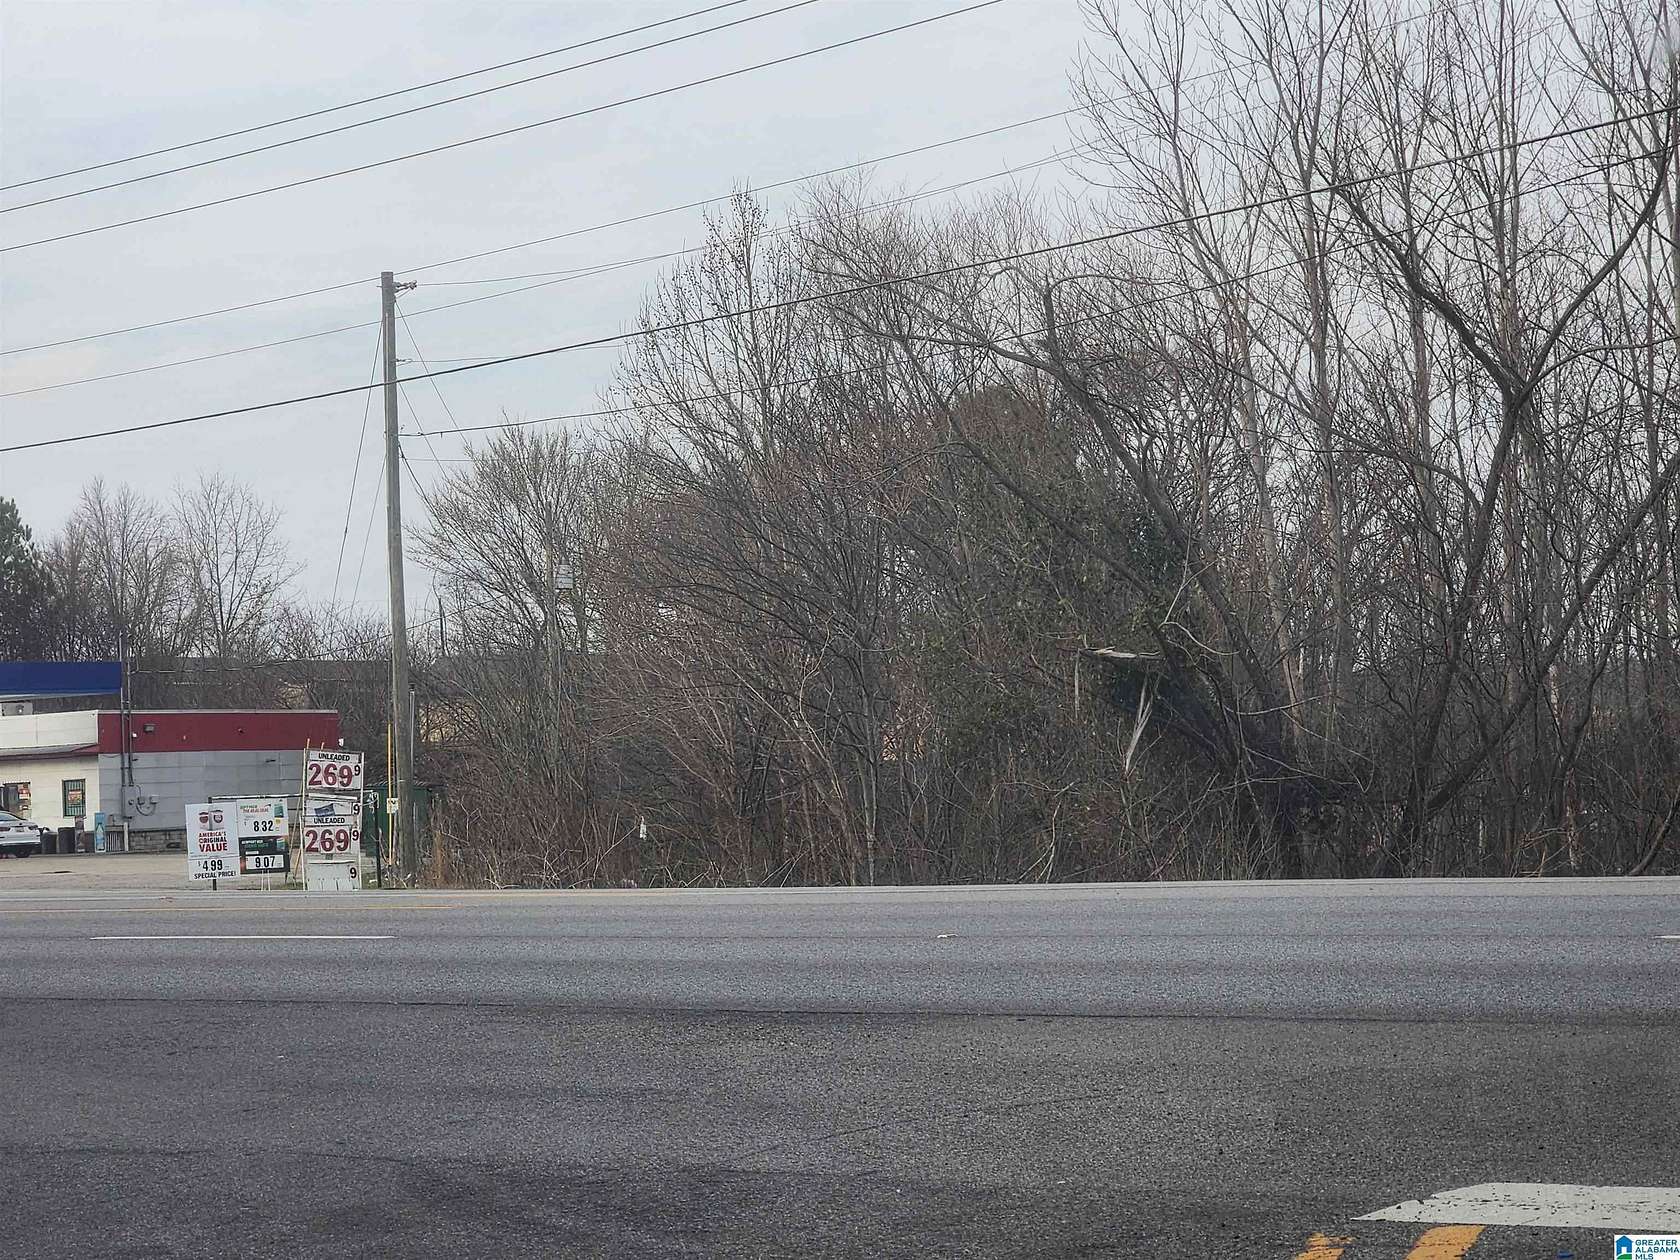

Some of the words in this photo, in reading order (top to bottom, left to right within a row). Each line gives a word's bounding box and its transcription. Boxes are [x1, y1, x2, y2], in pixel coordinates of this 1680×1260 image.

[318, 753, 351, 762] UNLEADED
[308, 763, 353, 787] 269
[354, 765, 361, 776] 9
[353, 804, 360, 815] 9
[313, 817, 346, 825] UNLEADED
[305, 829, 349, 853] 269
[352, 829, 359, 841] 9
[199, 843, 228, 853] VALUE
[194, 871, 217, 880] SPECIAL
[350, 867, 357, 879] 9
